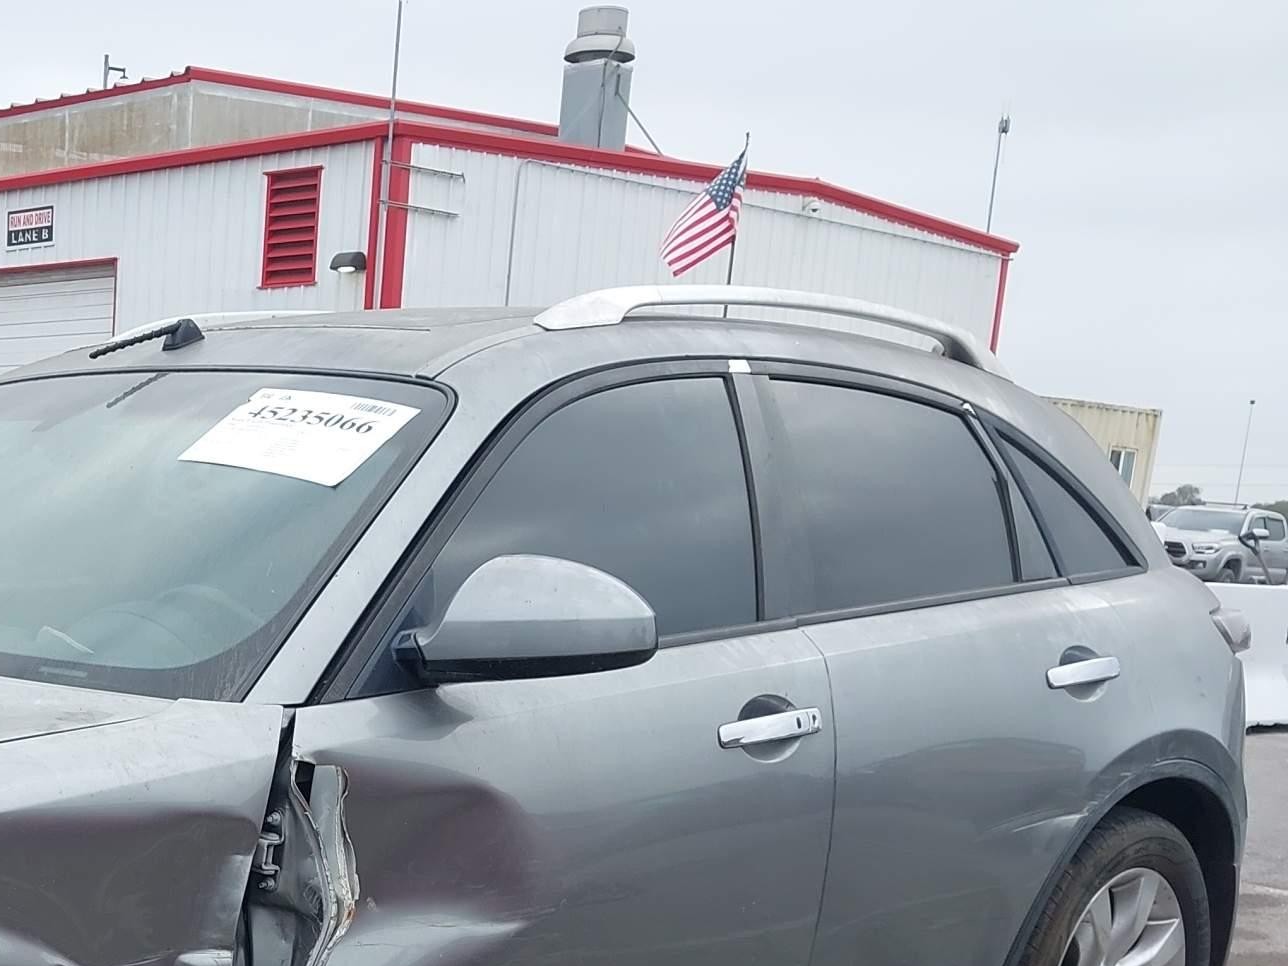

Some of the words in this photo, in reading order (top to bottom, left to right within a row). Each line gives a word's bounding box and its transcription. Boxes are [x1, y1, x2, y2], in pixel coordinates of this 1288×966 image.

[10, 214, 22, 228] RUN
[22, 212, 34, 226] AND
[34, 210, 51, 225] DRIVE
[11, 229, 39, 243] LANE
[42, 228, 49, 240] B
[248, 405, 376, 434] 45235066
